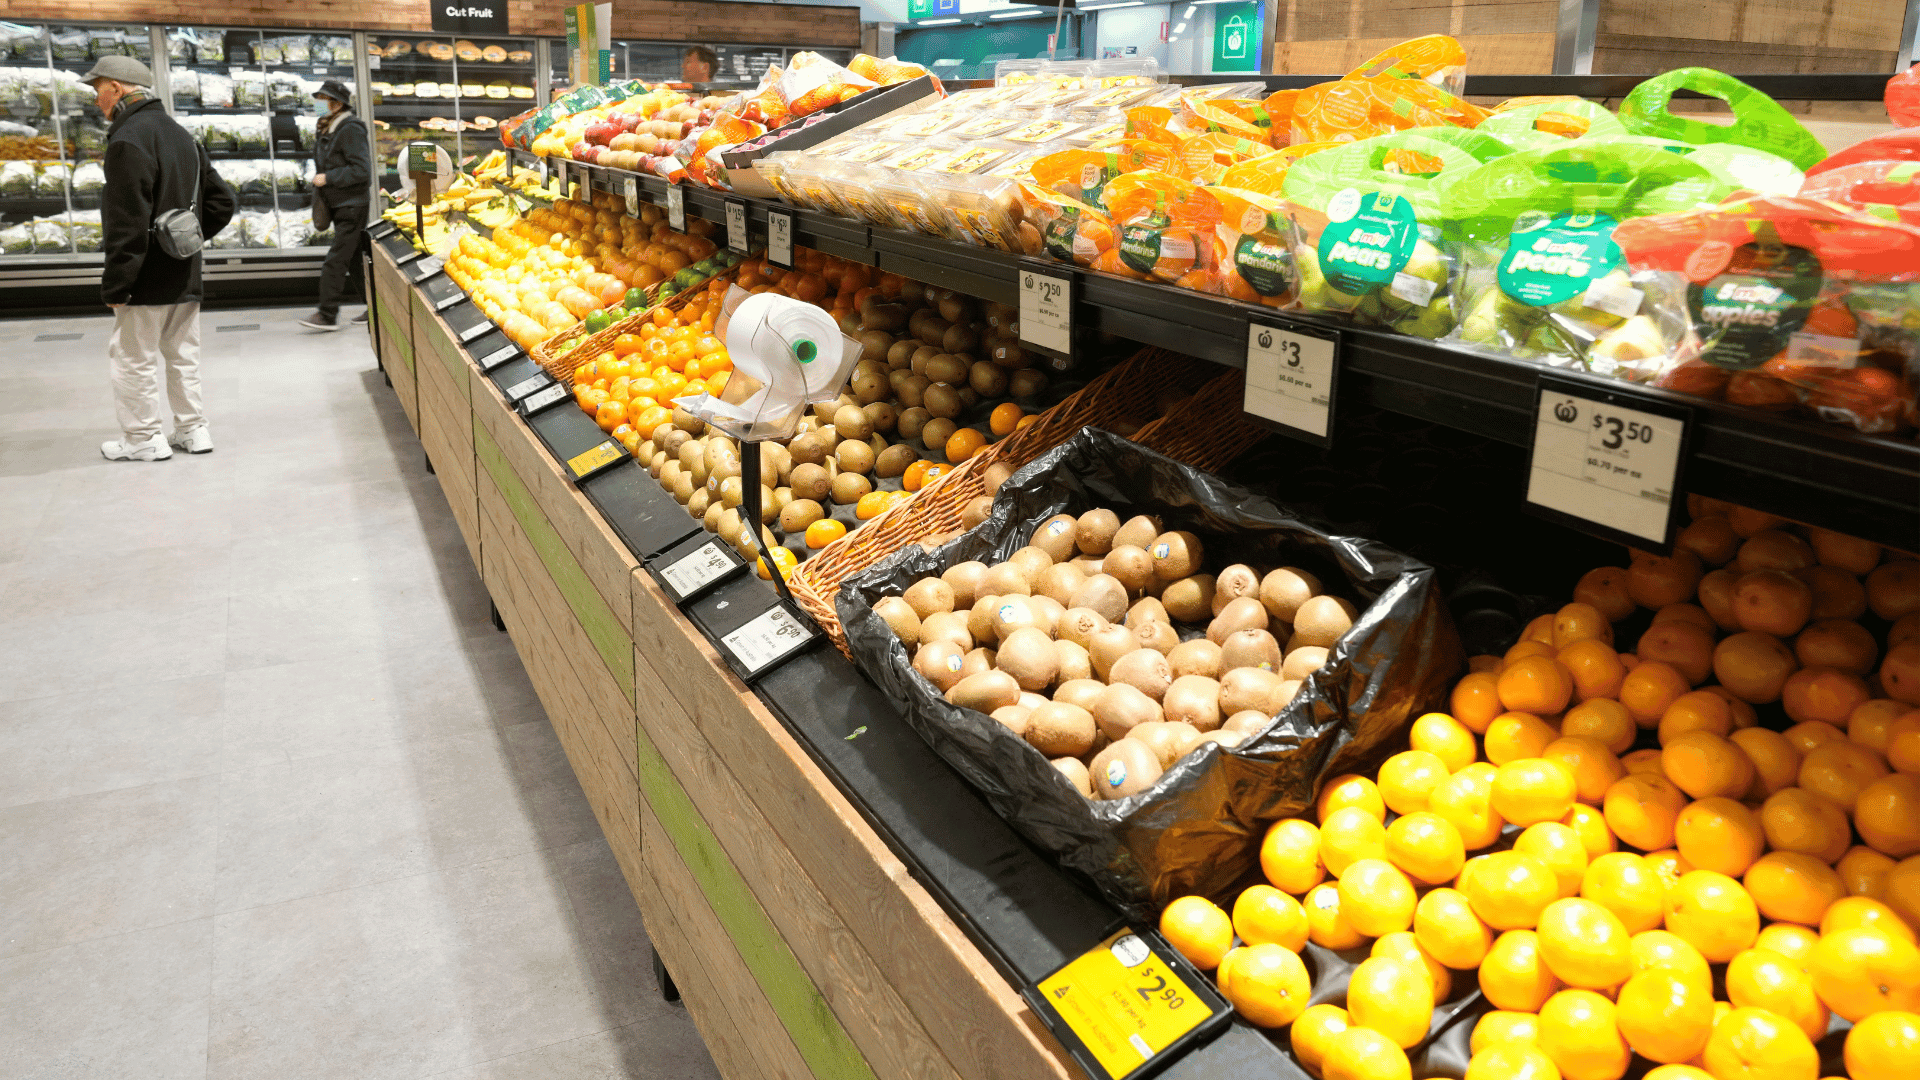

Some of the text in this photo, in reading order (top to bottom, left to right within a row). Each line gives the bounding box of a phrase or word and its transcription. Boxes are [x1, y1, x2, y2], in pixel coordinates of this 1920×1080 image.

[446, 6, 493, 18] Cut Fruit
[1327, 241, 1392, 270] pears
[1507, 250, 1592, 278] pears
[1701, 303, 1781, 328] apples
[1612, 464, 1628, 475] per
[1630, 470, 1642, 479] ea
[1117, 940, 1139, 963] Special
[1065, 994, 1085, 1018] Grown
[1092, 1023, 1117, 1055] Australia
[1127, 1006, 1140, 1020] per
[1136, 1018, 1147, 1029] kg
